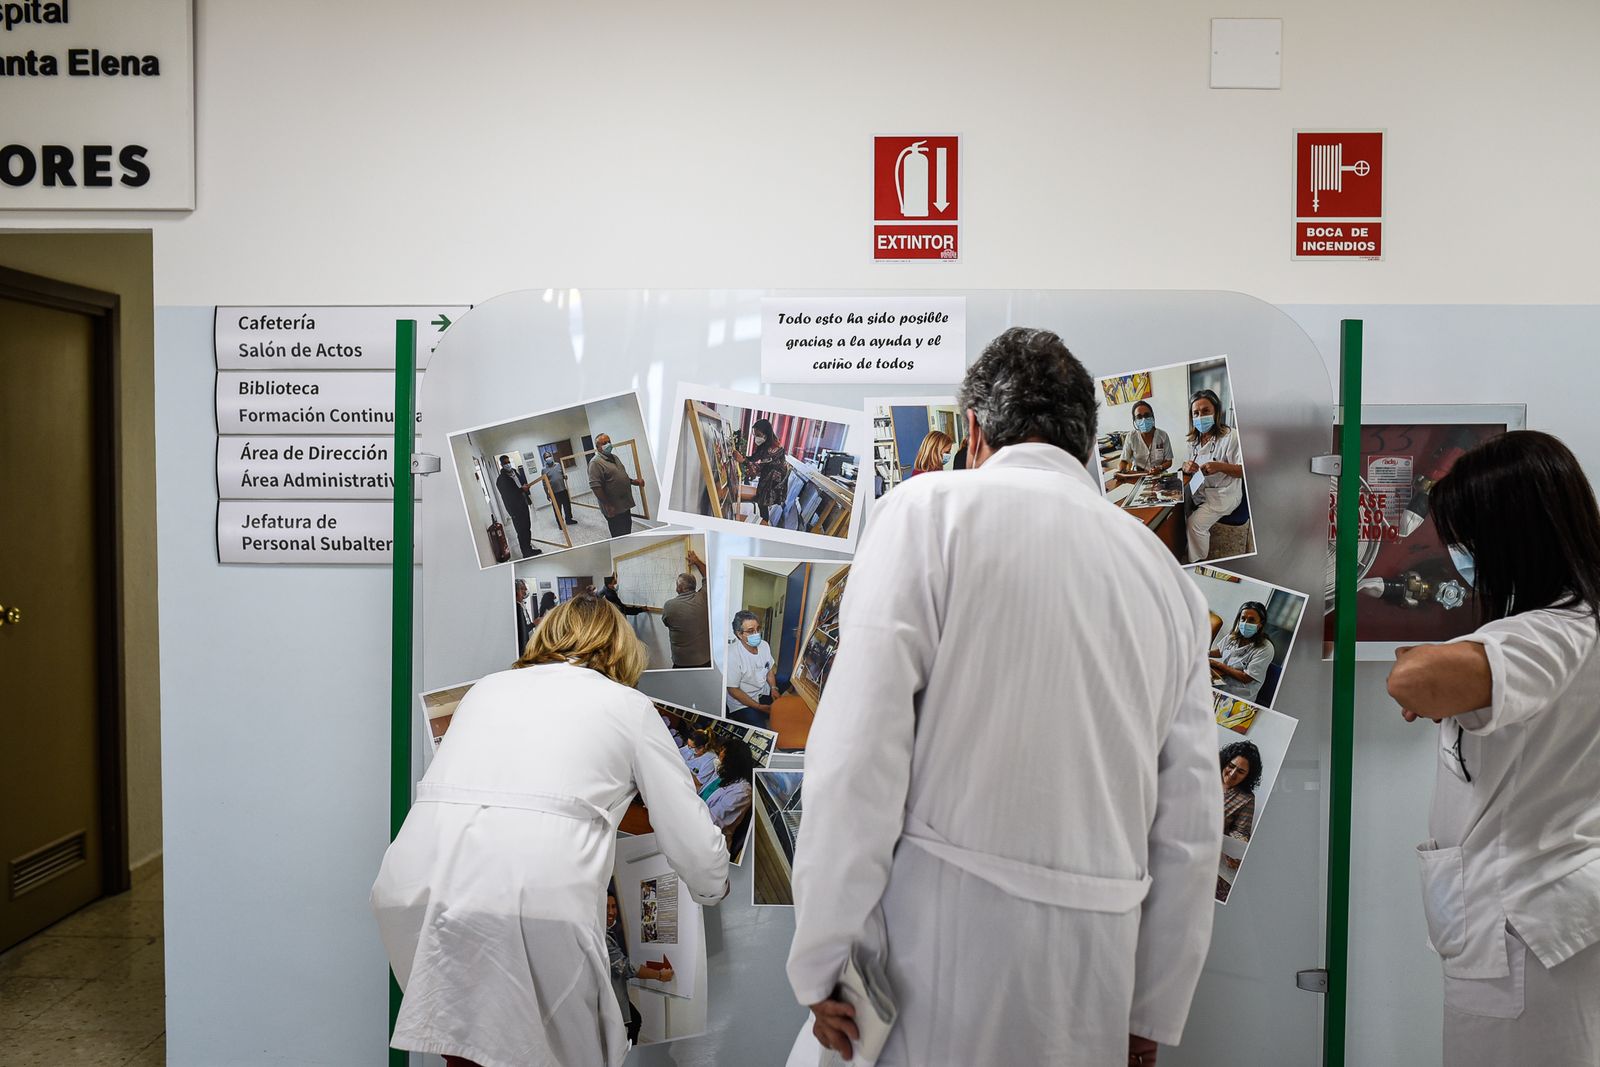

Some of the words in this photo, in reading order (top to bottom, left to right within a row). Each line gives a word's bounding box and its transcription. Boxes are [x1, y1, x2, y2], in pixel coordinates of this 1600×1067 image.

[0, 0, 69, 32] pital
[0, 49, 59, 77] nta
[67, 48, 160, 77] Elena
[0, 143, 150, 187] ORES
[1306, 227, 1344, 238] BOCA
[1351, 227, 1369, 238] DE
[877, 234, 954, 250] EXTINTOR
[1302, 241, 1376, 252] INCENDIOS
[238, 313, 315, 330] Cafetería
[778, 312, 812, 325] Todo
[815, 313, 843, 326] esto
[846, 312, 864, 324] ha
[867, 312, 896, 325] sido
[899, 311, 949, 327] posible
[238, 341, 286, 358] Salón
[290, 343, 312, 358] de
[315, 344, 363, 358] Actos
[785, 335, 833, 351] gracias
[836, 339, 846, 347] a
[849, 335, 866, 347] la
[869, 335, 912, 349] ayuda
[915, 337, 924, 349] y
[927, 334, 942, 346] el
[809, 356, 853, 370] cariño
[857, 357, 872, 370] de
[875, 357, 915, 371] todos
[238, 380, 319, 395] Biblioteca
[238, 406, 325, 422] Formación
[240, 442, 279, 460] Área
[283, 445, 304, 460] de
[308, 443, 388, 460] Dirección
[240, 469, 279, 487] Área
[283, 472, 394, 488] Administrativ
[241, 513, 312, 529] Jefatura
[316, 514, 337, 529] de
[241, 536, 316, 551] Personal
[320, 536, 393, 551] Subalter
